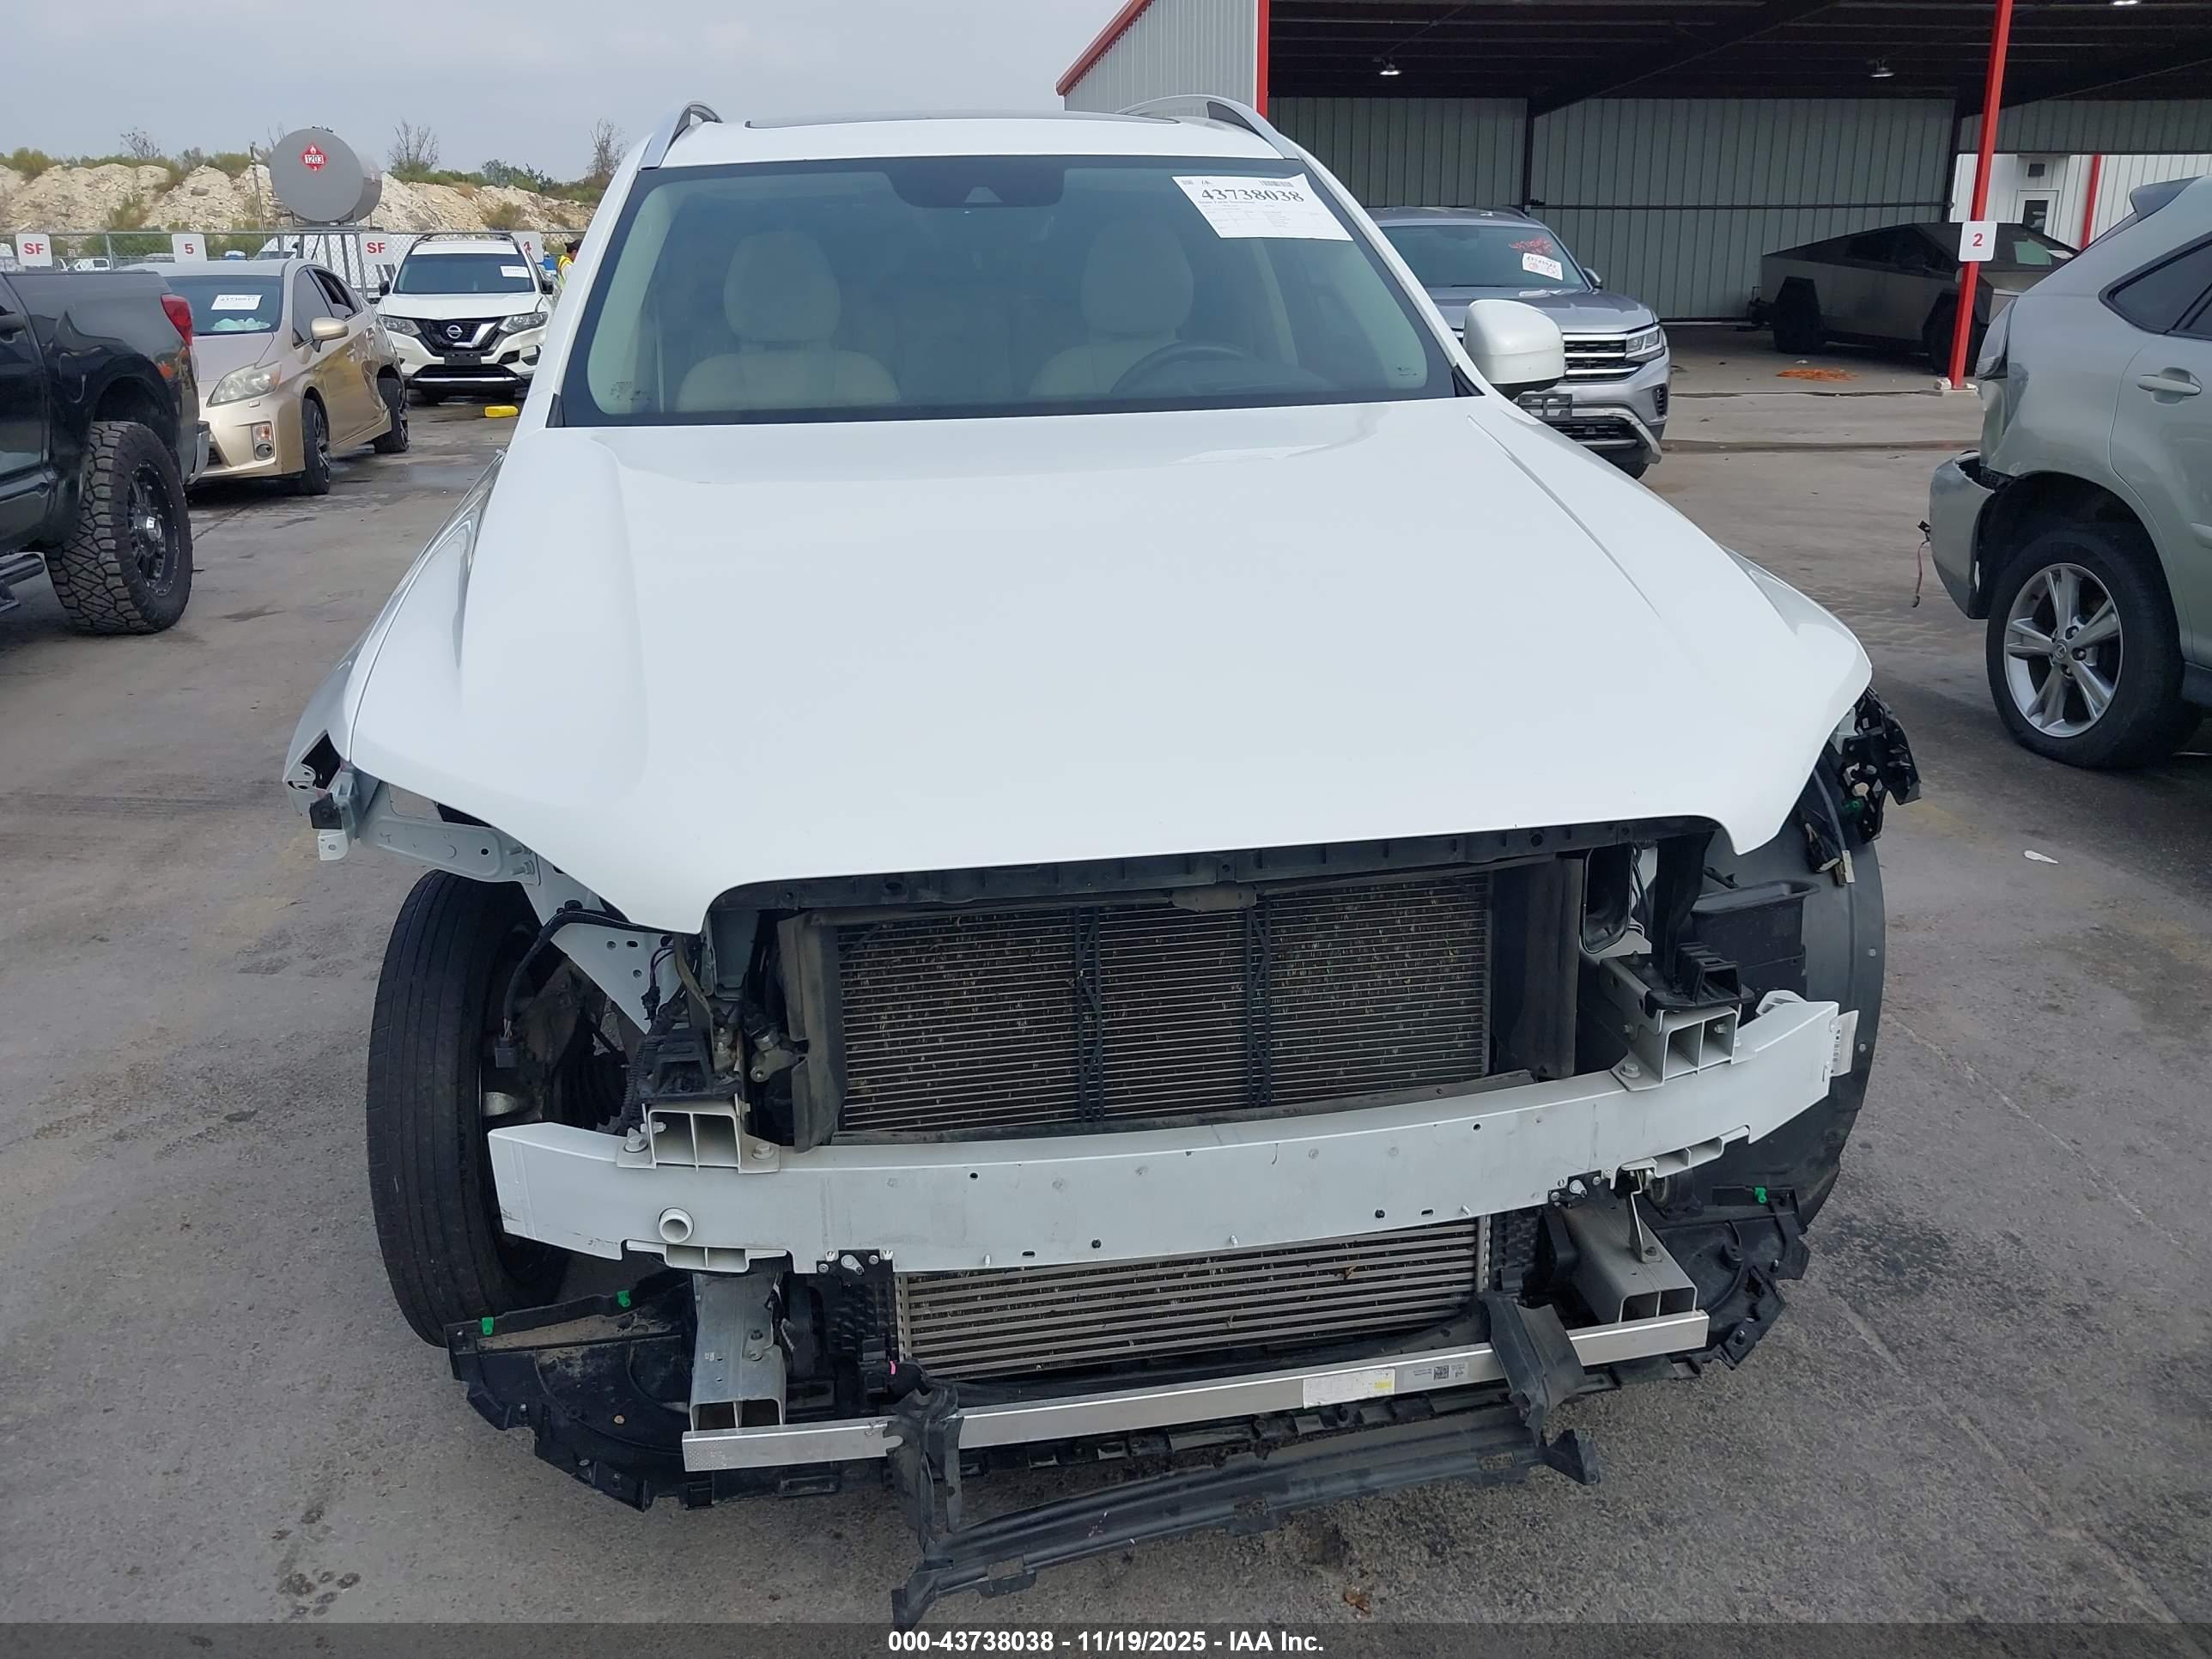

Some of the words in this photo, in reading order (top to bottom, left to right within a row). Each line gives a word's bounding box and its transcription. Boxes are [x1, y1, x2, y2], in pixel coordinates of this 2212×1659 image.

[1202, 188, 1304, 203] 43738038
[1972, 233, 1984, 247] 2
[23, 242, 44, 255] SF
[185, 243, 194, 255] 5
[366, 241, 386, 254] SF
